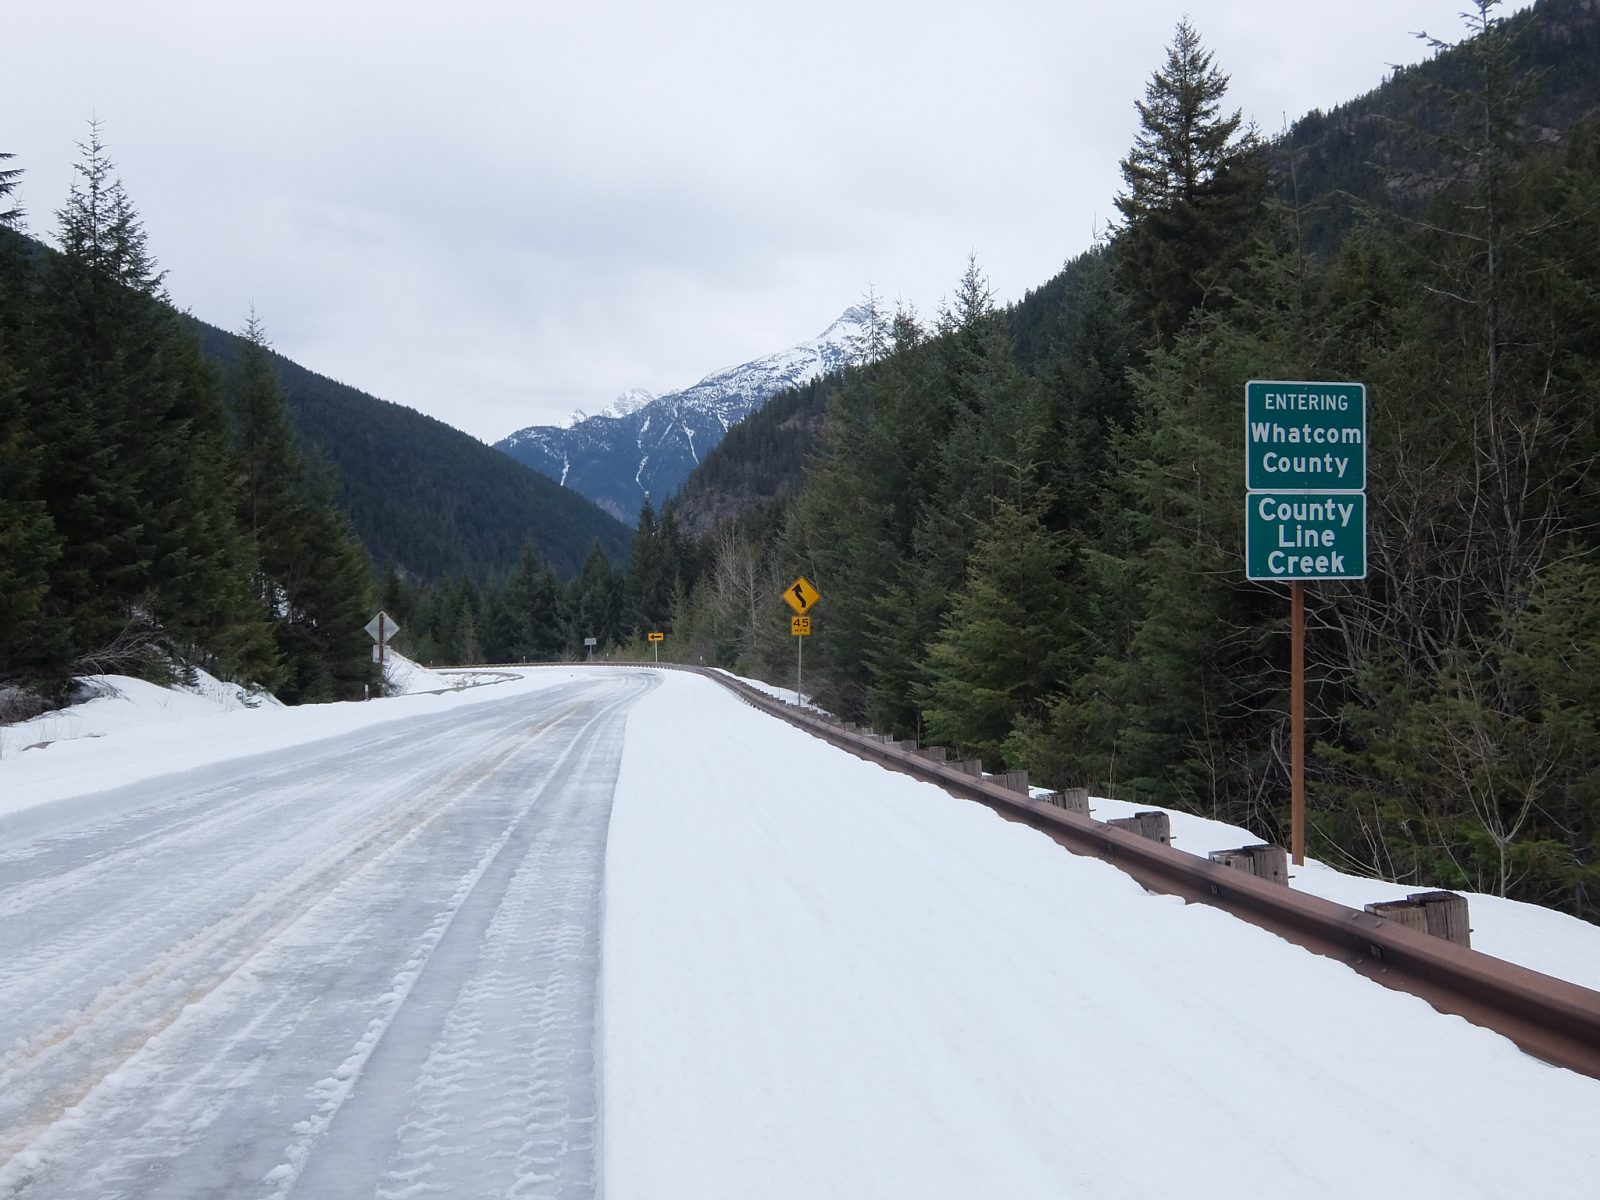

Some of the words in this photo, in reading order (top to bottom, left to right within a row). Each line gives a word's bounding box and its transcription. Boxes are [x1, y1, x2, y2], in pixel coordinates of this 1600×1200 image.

[1265, 393, 1348, 411] ENTERING
[1251, 422, 1361, 443] Whatcom
[1263, 452, 1349, 478] County
[1258, 497, 1354, 527] County
[1278, 524, 1335, 547] Line
[1267, 550, 1345, 574] Creek
[793, 618, 809, 627] 45
